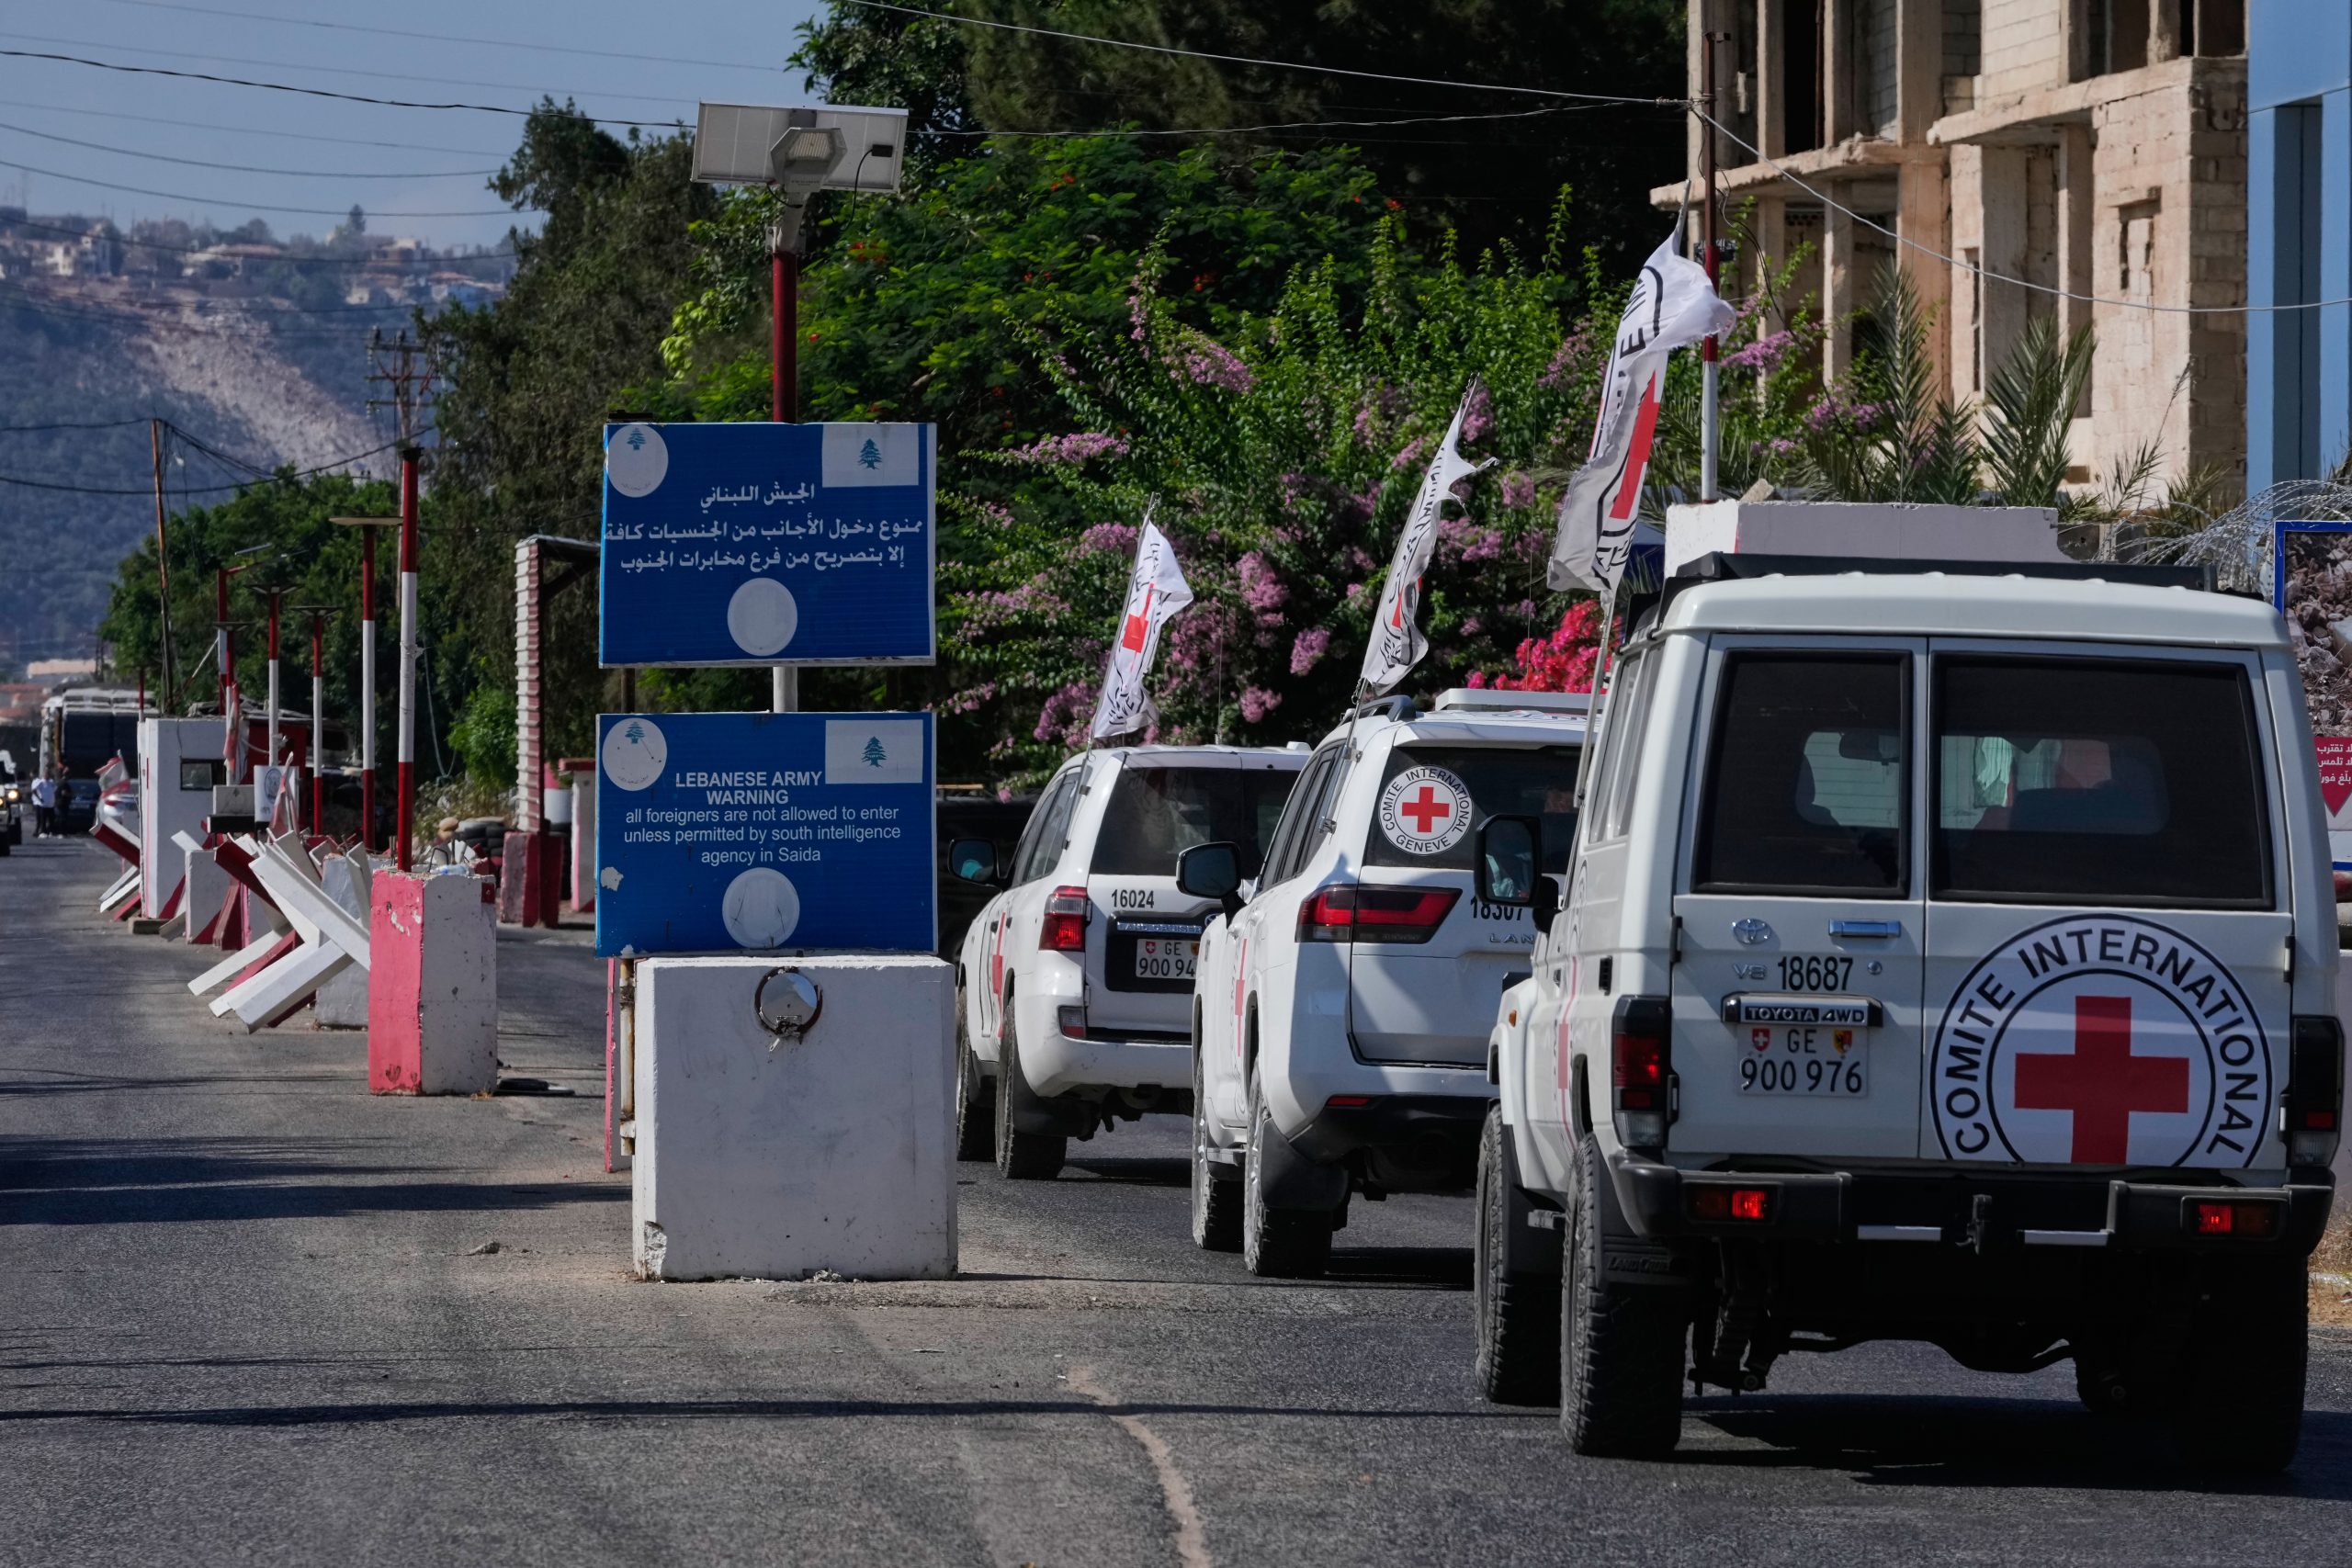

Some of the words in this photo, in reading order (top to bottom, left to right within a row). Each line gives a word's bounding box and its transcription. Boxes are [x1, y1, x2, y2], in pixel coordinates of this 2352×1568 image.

[700, 484, 759, 513] اللبناني
[763, 481, 815, 505] الجيش
[605, 523, 645, 541] كافة
[648, 520, 728, 544] الجنسيات
[731, 524, 757, 542] من
[761, 512, 823, 541] الأجانب
[829, 518, 874, 540] دخول
[878, 518, 923, 541] ممنوع
[620, 549, 674, 573] الجنوب
[679, 549, 746, 571] مخابرات
[750, 547, 781, 573] فرع
[785, 551, 810, 569] من
[814, 547, 883, 570] بتصريح
[888, 545, 905, 569] إلا
[675, 772, 767, 787] LEBANESE
[771, 771, 823, 786] ARMY
[1382, 782, 1402, 831] COMITE
[1405, 768, 1470, 833] INTERNATIONAL
[626, 808, 642, 823] all
[646, 807, 719, 826] foreigners
[724, 809, 749, 822] are
[752, 807, 776, 821] not
[780, 806, 837, 821] allowed
[842, 806, 856, 820] to
[860, 806, 899, 820] enter
[624, 828, 671, 842] unless
[675, 827, 744, 845] permitted
[749, 827, 767, 844] by
[771, 826, 813, 840] south
[817, 825, 901, 843] intelligence
[1396, 834, 1452, 852] GENEVE
[701, 850, 756, 867] agency
[760, 848, 774, 863] in
[778, 847, 821, 862] Saida
[1111, 889, 1155, 908] 16024
[1164, 942, 1182, 956] GE
[1138, 957, 1170, 976] 900
[1733, 964, 1768, 980] V8
[1777, 955, 1854, 991] 18687
[1747, 1007, 1816, 1021] TOYOTA
[1820, 1009, 1866, 1023] 4WD
[1787, 1028, 1817, 1054] GE
[1944, 973, 2017, 1154] COMITE
[2017, 927, 2259, 1156] INTERNATIONAL
[1740, 1057, 1797, 1091] 900
[1805, 1059, 1862, 1094] 976
